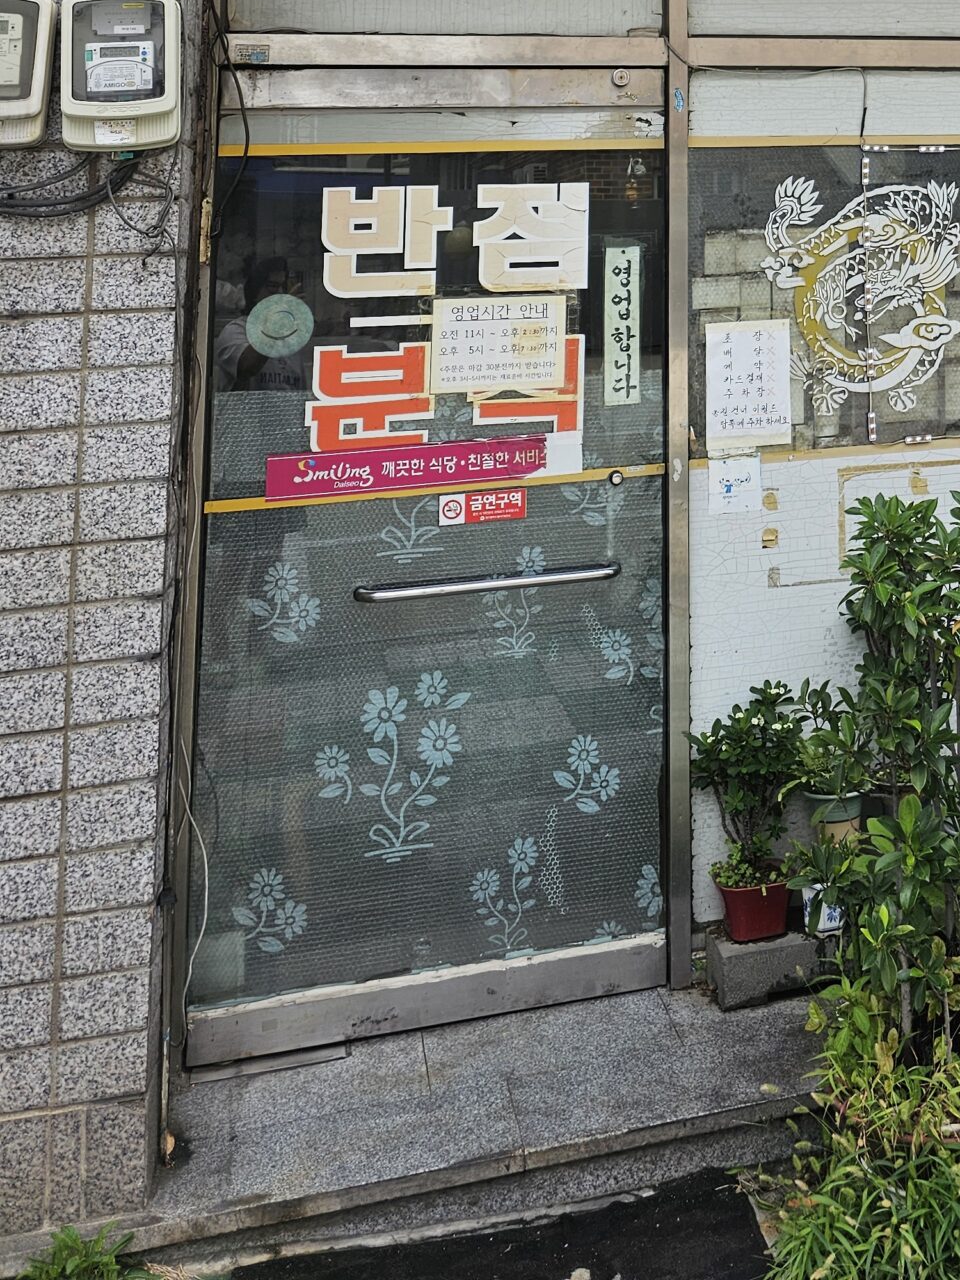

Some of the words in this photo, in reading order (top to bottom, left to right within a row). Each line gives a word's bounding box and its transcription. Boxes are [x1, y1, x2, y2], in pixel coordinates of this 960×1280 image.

[320, 182, 590, 298] 반점
[451, 304, 511, 321] 영업시간
[520, 303, 548, 318] 안내
[440, 329, 458, 340] 오전
[465, 329, 484, 339] 11시
[611, 259, 637, 400] 영업합니다
[440, 346, 458, 356] 오후
[468, 345, 484, 356] 5시
[468, 363, 482, 372] 마감
[293, 459, 374, 487] Smiling
[381, 456, 425, 478] 깨끗한
[469, 491, 522, 511] 금연구역
